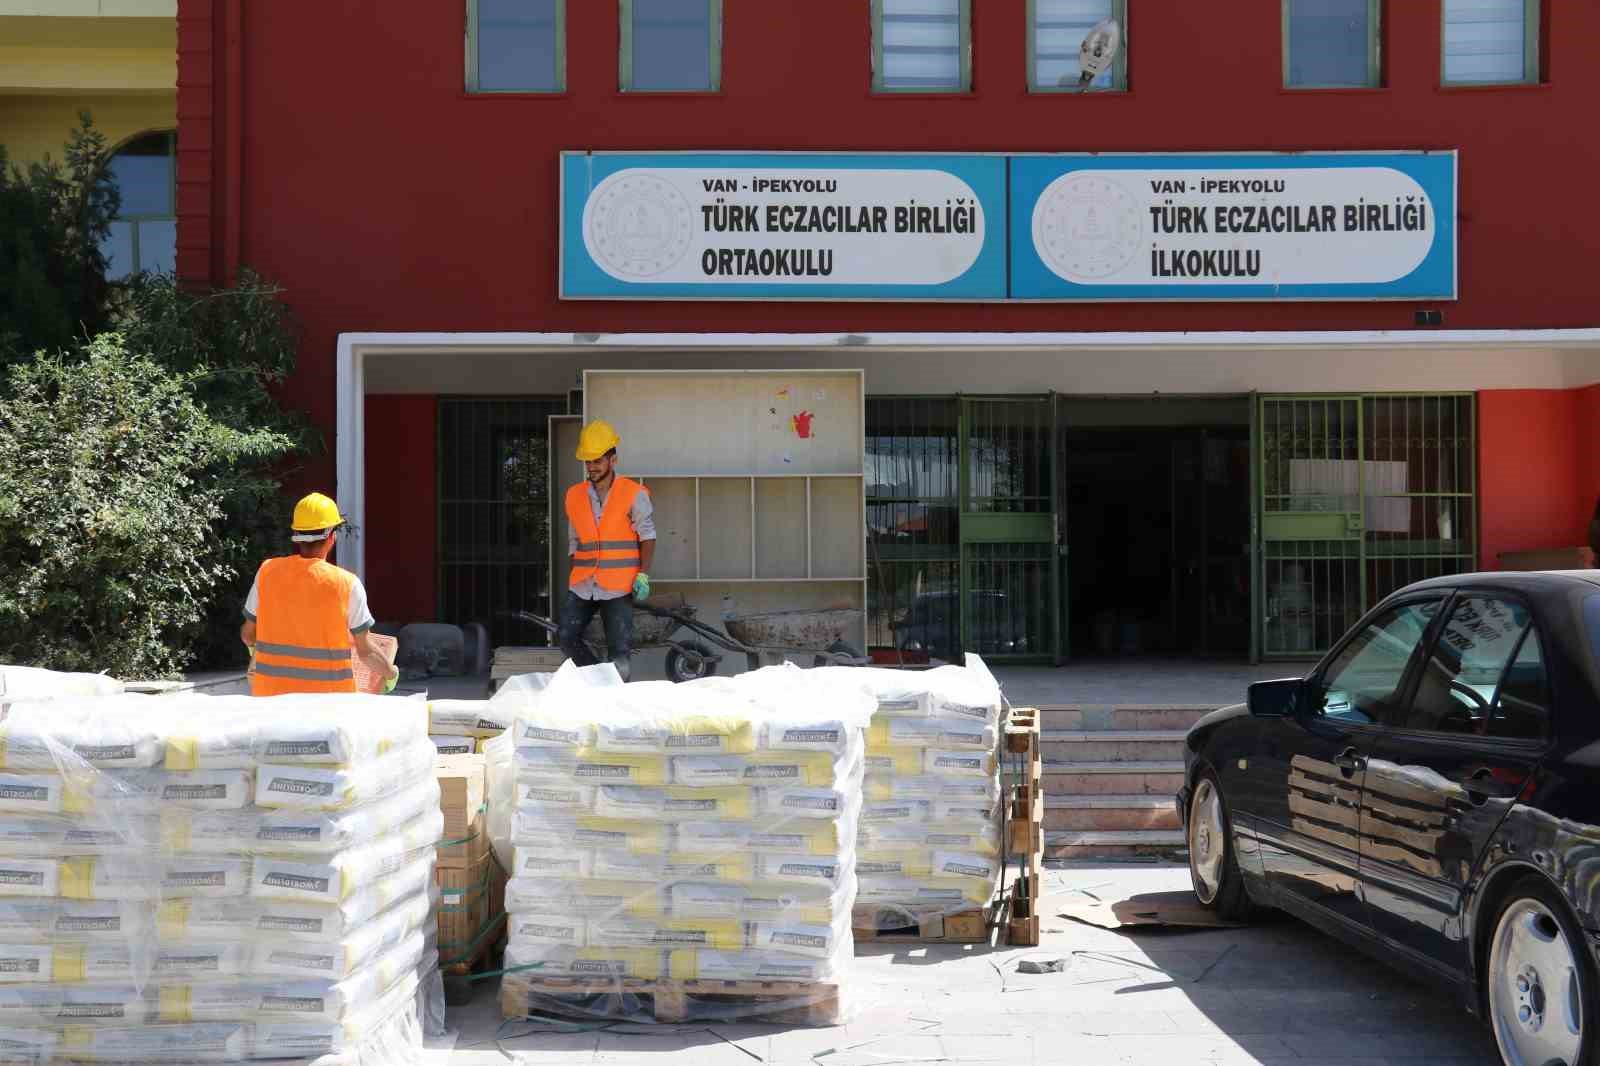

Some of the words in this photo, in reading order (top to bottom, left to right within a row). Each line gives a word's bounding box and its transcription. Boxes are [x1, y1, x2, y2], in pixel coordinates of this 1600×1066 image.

[702, 179, 738, 193] VAN
[752, 176, 837, 193] İPEKYOLU
[1151, 180, 1186, 194] VAN
[1200, 176, 1285, 193] İPEKYOLU
[701, 198, 760, 233] TÜRK
[766, 205, 888, 233] ECZACILAR
[894, 198, 976, 234] BİRLİĞİ
[1150, 199, 1208, 233] TÜRK
[1214, 205, 1337, 233] ECZACILAR
[1343, 195, 1426, 232] BİRLİĞİ
[702, 248, 833, 276] ORTAOKULU
[1151, 242, 1260, 277] İLKOKULU
